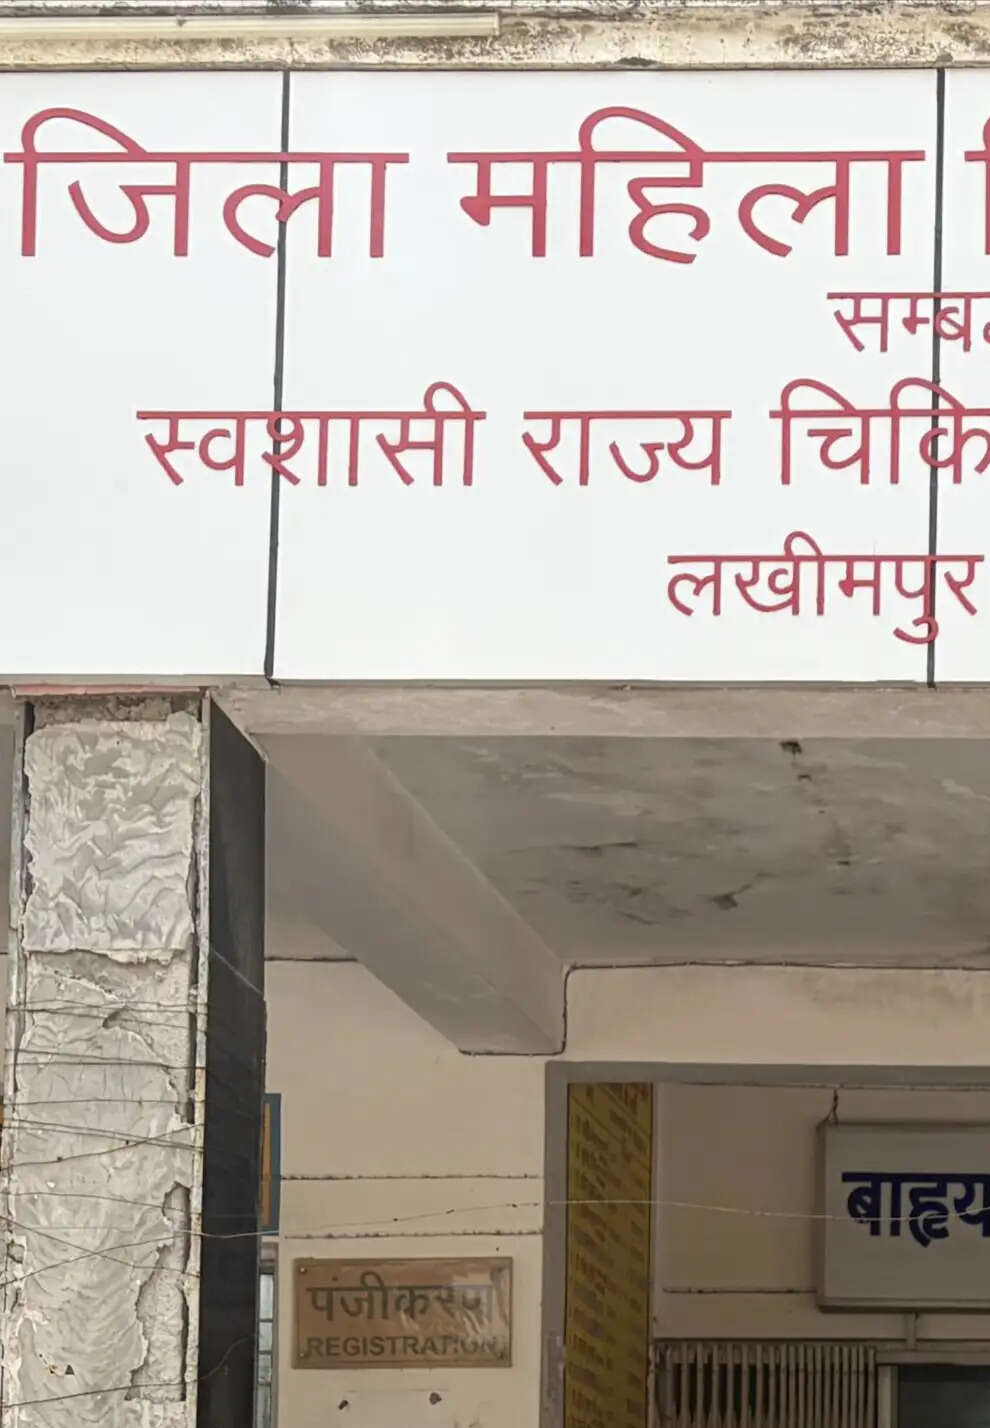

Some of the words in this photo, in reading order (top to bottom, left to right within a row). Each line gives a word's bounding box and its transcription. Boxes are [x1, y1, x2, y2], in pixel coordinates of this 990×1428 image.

[5, 109, 408, 257] जिला
[448, 108, 925, 263] महिला
[137, 381, 486, 486] स्वशासी
[523, 410, 732, 486] राज्य
[667, 531, 984, 645] लखीमपुर
